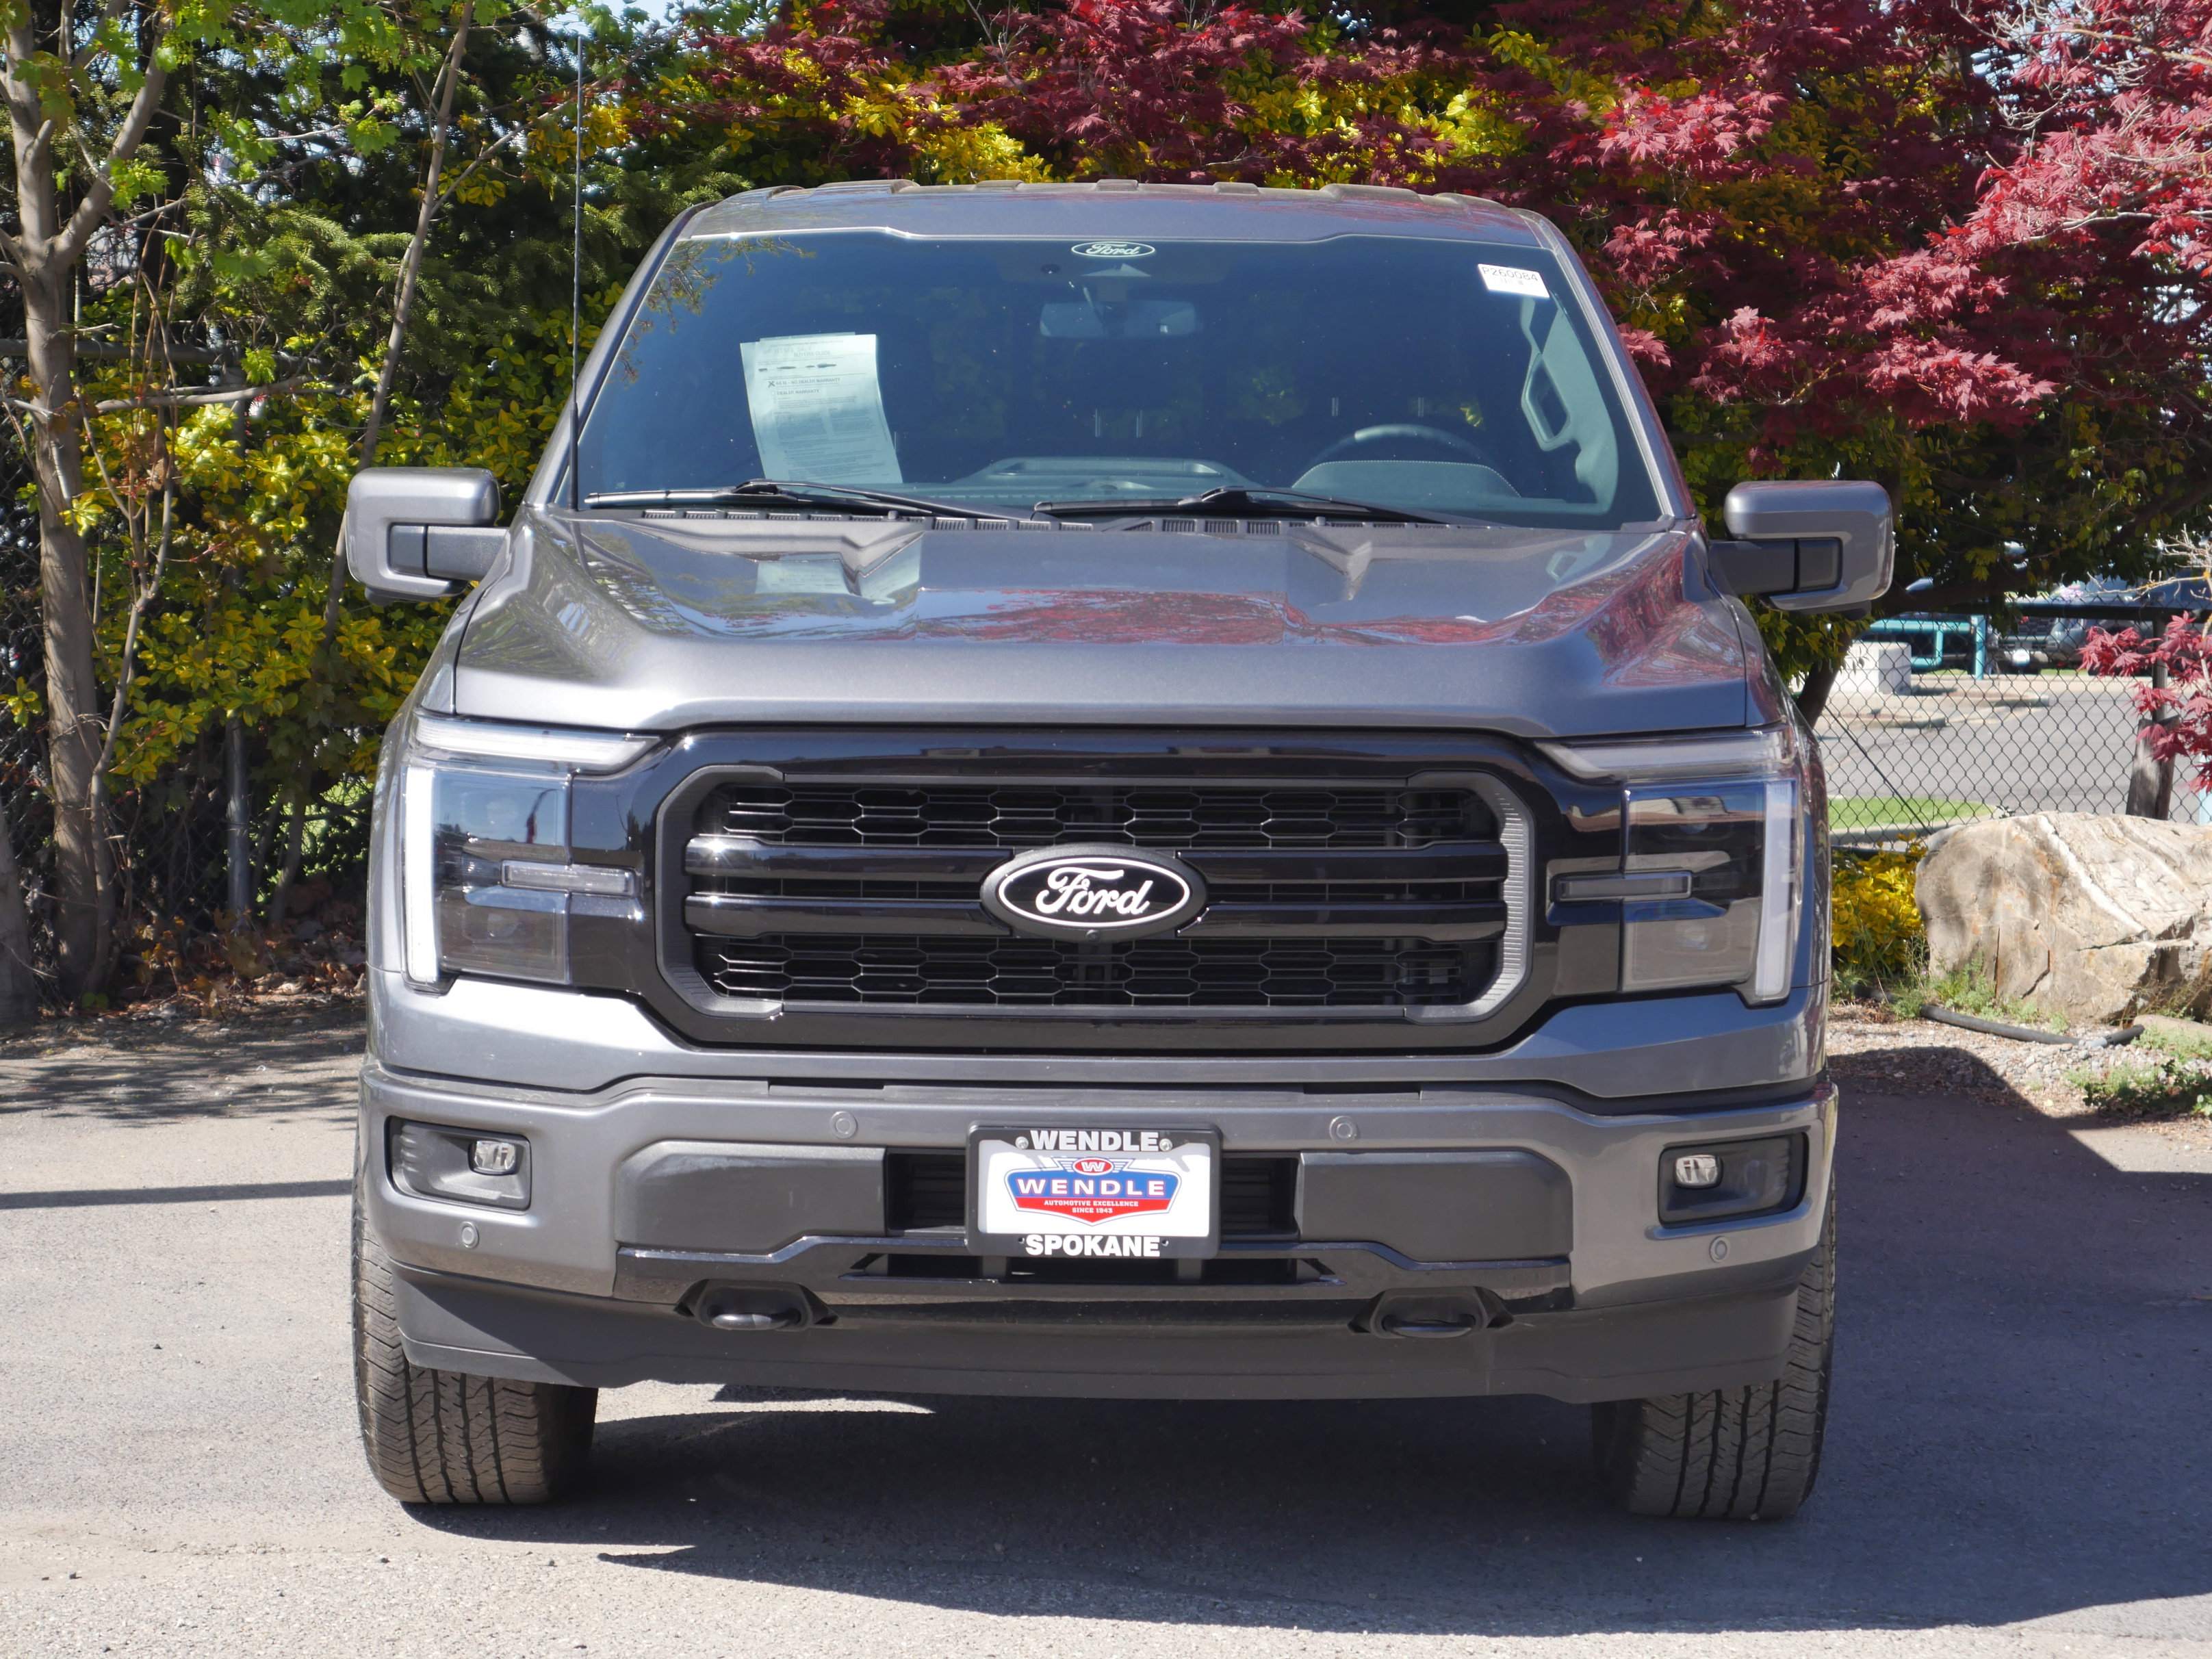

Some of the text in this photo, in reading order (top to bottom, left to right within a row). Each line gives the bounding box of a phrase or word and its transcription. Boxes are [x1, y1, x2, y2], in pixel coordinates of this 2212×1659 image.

[1086, 243, 1141, 255] Ford
[1481, 267, 1538, 281] P260084
[1036, 866, 1153, 914] Ford
[1030, 1130, 1159, 1151] WENDLE
[1016, 1179, 1166, 1196] WENDLE
[1025, 1234, 1161, 1257] SPOKANE
